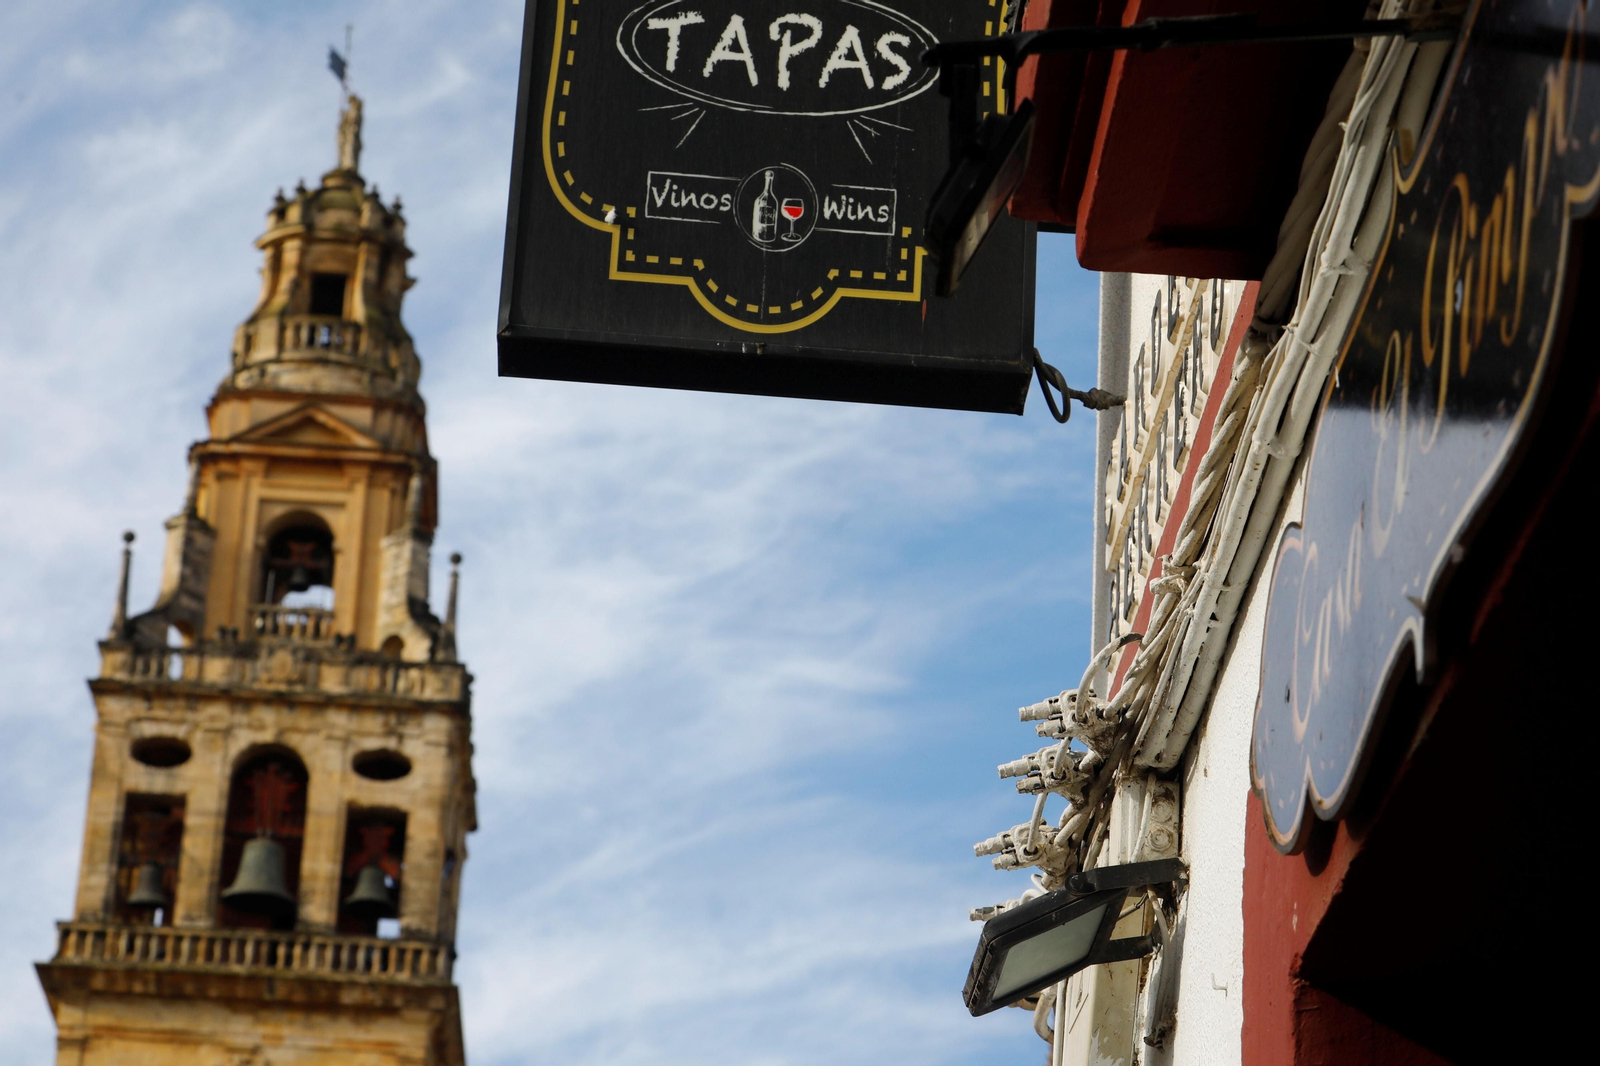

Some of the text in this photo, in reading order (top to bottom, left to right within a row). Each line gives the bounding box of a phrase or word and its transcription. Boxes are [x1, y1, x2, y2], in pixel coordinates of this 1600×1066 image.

[647, 11, 912, 91] TAPAS
[651, 178, 890, 222] Vinos Wins
[1105, 275, 1190, 545] CARDE
[1293, 510, 1363, 744] Casa
[1371, 330, 1413, 559] El
